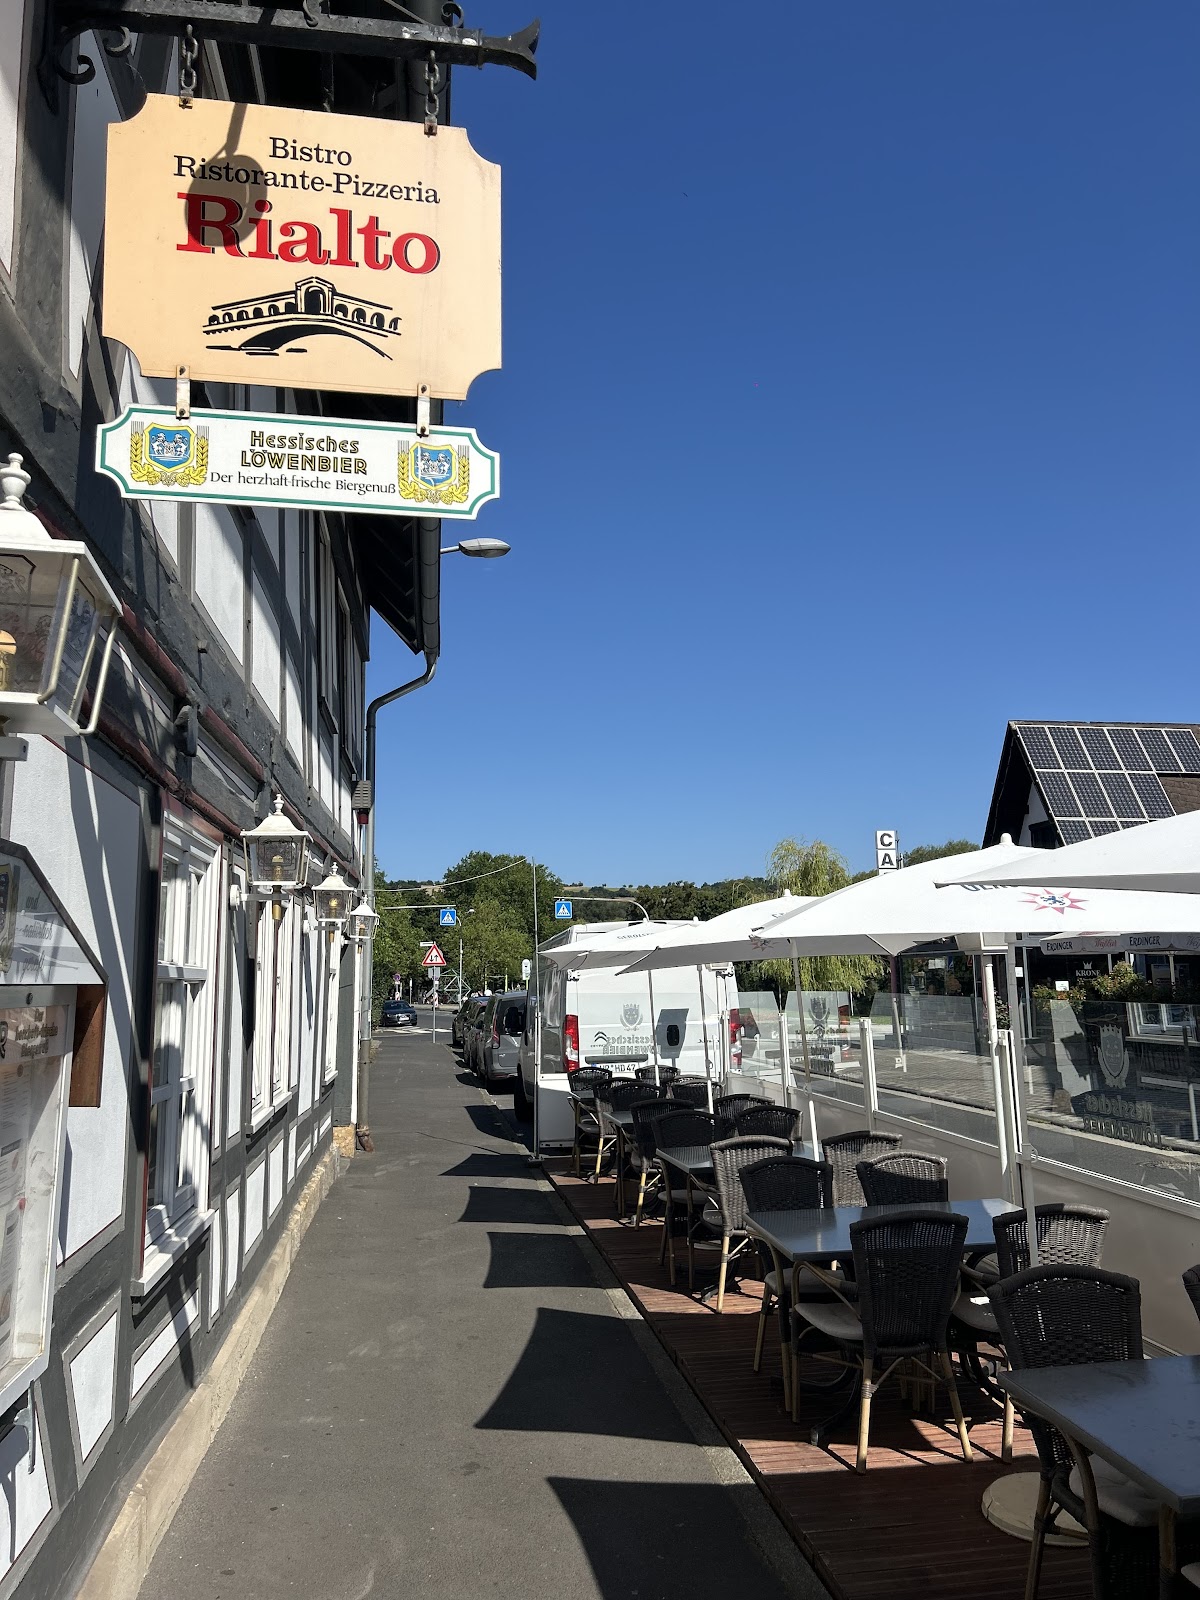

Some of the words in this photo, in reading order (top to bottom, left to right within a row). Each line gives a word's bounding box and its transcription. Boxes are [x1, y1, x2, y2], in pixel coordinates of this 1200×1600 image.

[269, 136, 353, 166] Bistro
[173, 154, 441, 204] Ristorante-Pizzeria
[176, 191, 441, 275] Rialto
[250, 430, 360, 454] Hessisches
[241, 449, 368, 475] LÖWENBIER
[210, 471, 234, 483] Der
[238, 471, 331, 489] herzhaft-frische
[335, 479, 396, 495] Biergenuß
[1046, 941, 1073, 951] ERDINGER
[1129, 935, 1161, 947] ERDINGER
[1075, 969, 1101, 977] KRONE
